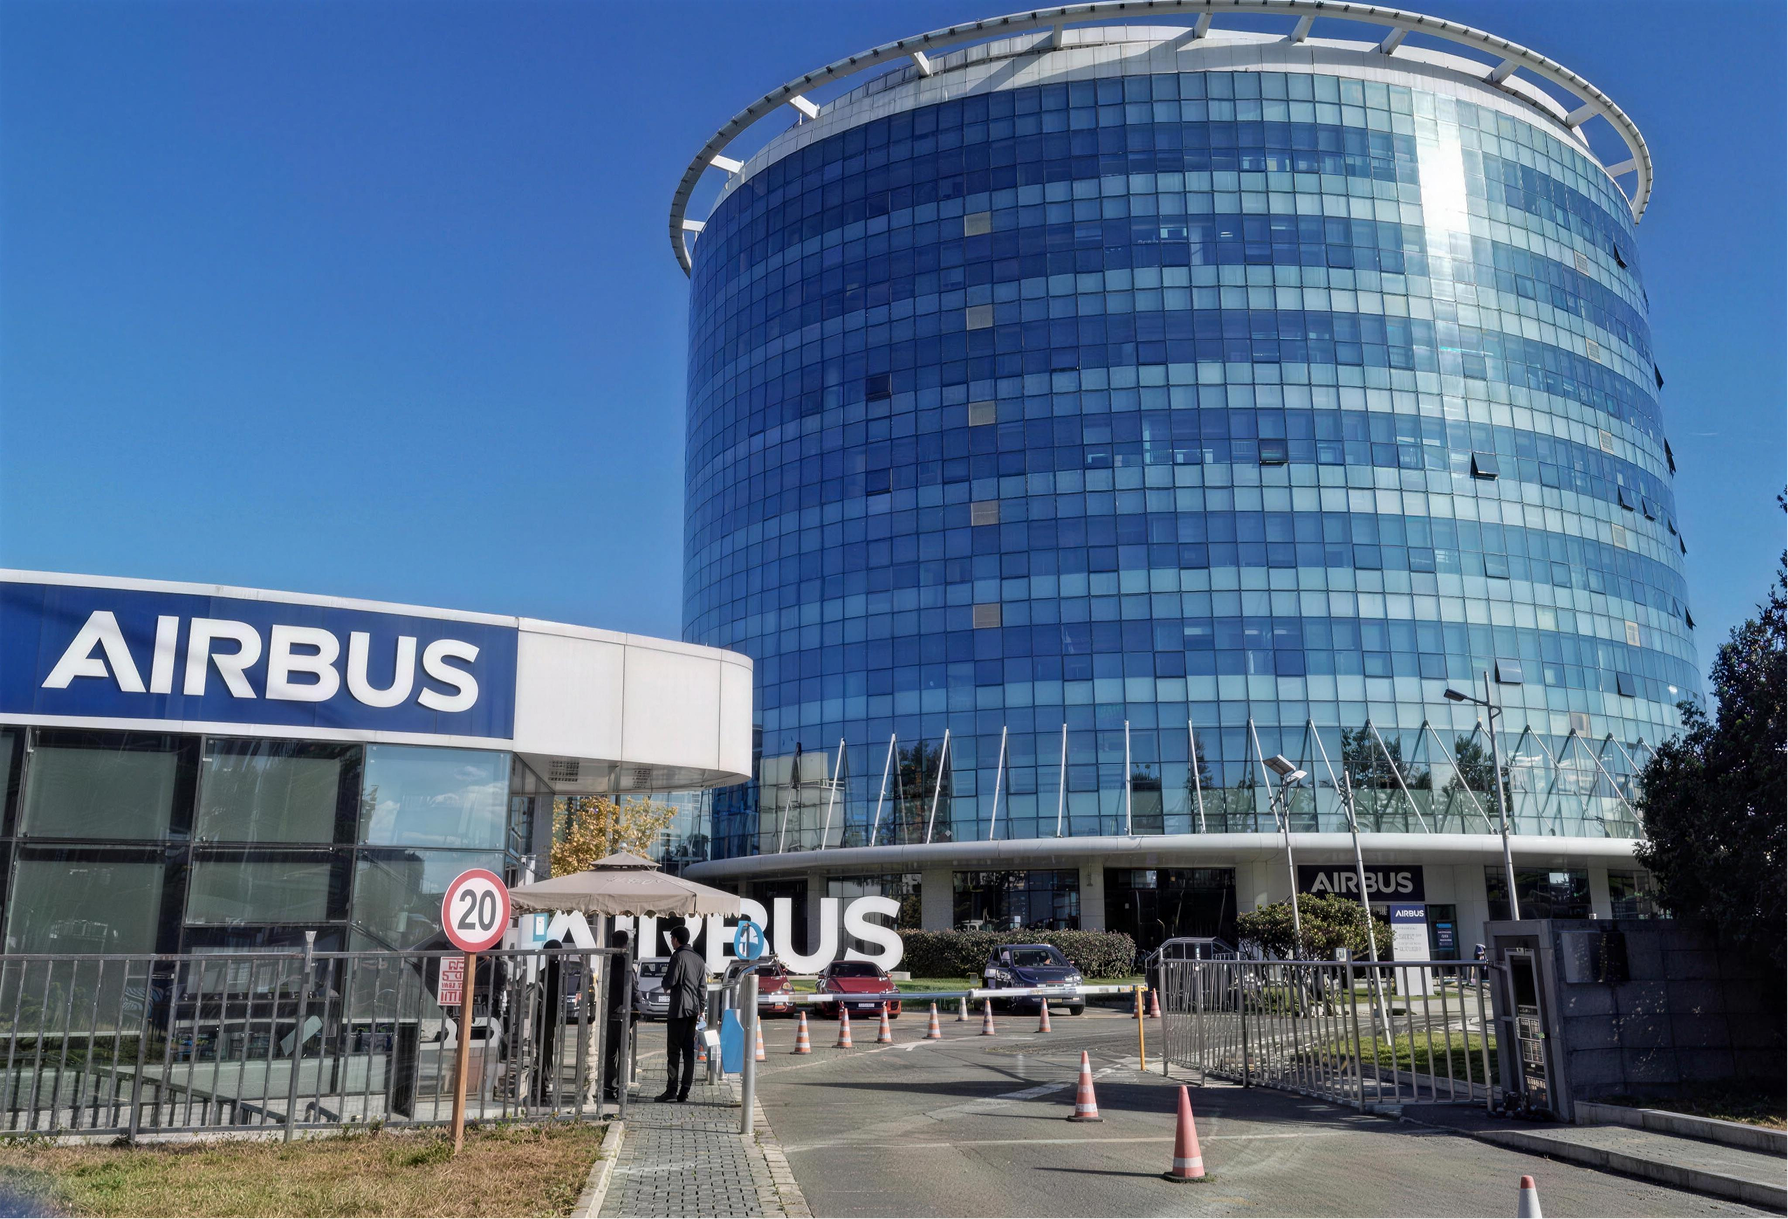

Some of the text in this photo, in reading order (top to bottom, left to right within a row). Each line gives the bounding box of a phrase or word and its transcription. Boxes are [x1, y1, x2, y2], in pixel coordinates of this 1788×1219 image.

[41, 610, 480, 713] AIRBUS
[1310, 872, 1413, 893] AIRBUS
[457, 889, 497, 932] 20
[1395, 909, 1425, 918] AIRBUS
[525, 896, 904, 975] ABUS
